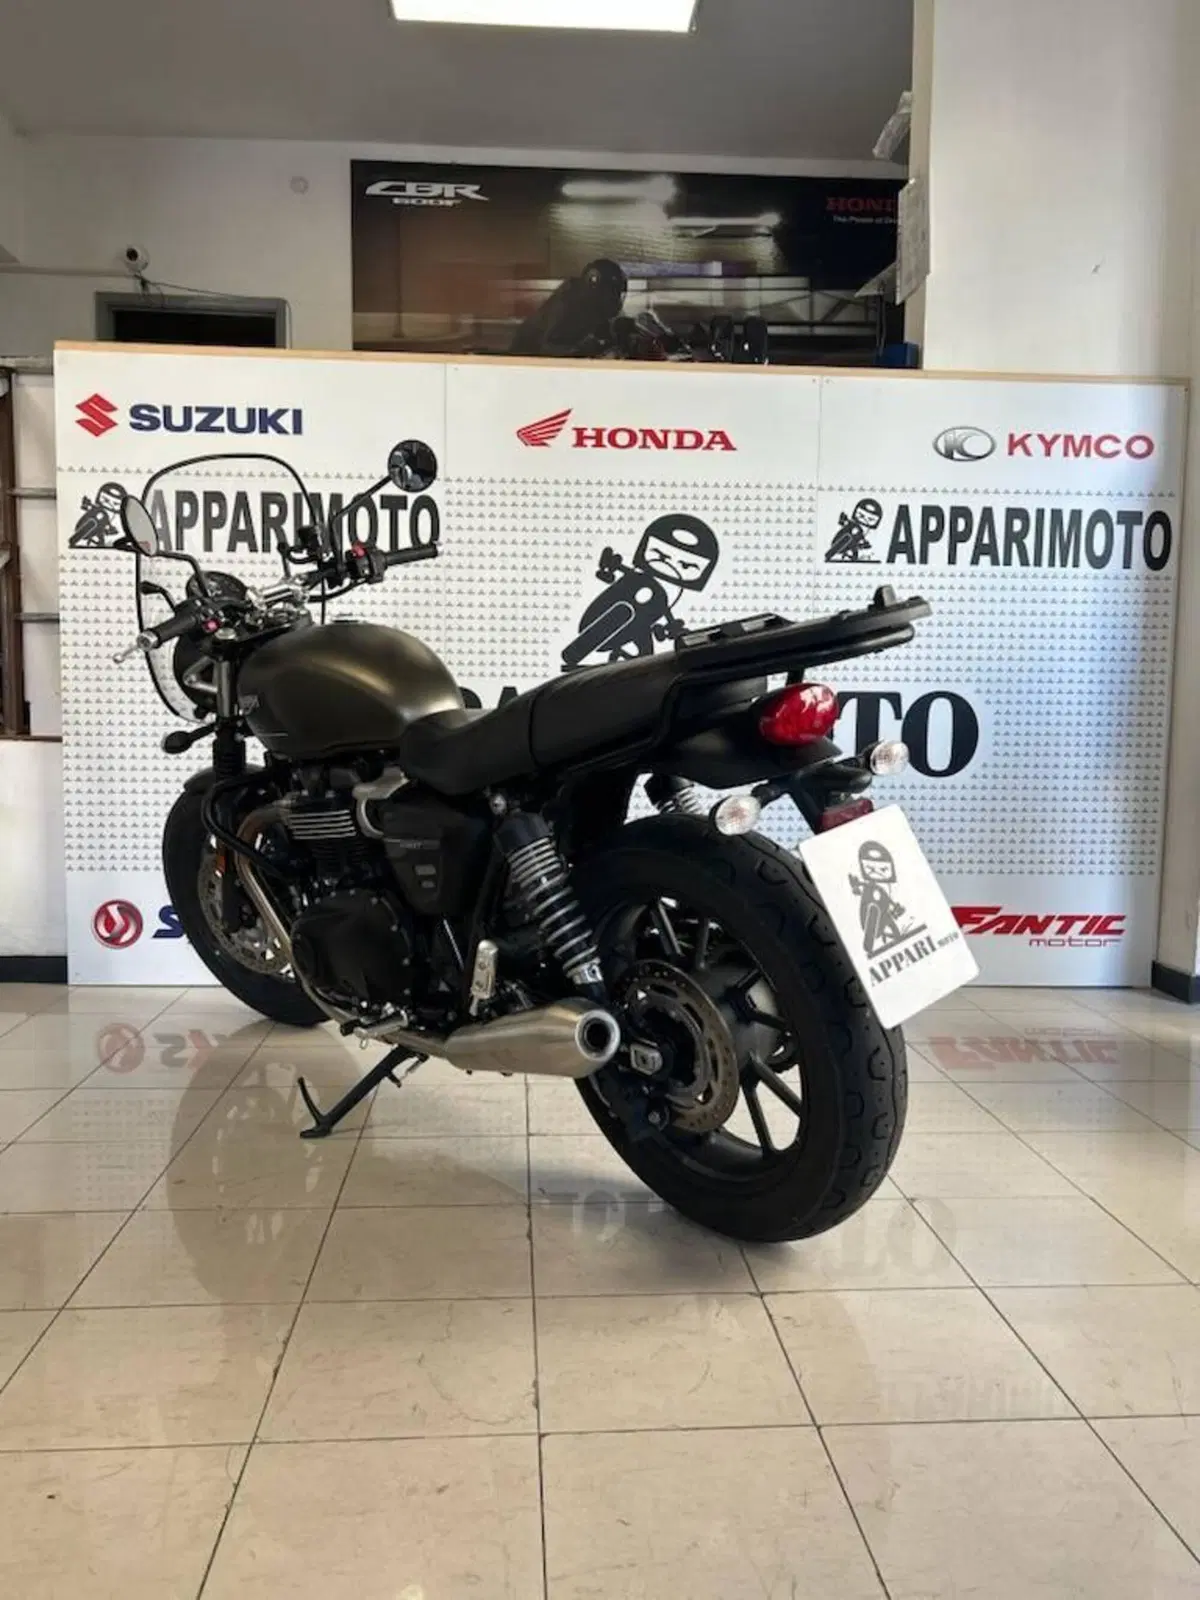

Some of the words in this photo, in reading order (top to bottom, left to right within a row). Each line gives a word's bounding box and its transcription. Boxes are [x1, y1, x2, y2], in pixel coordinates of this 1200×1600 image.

[365, 181, 489, 201] CBR
[129, 404, 303, 435] SUZUKI
[572, 427, 737, 451] HONDA
[1007, 433, 1155, 460] KYMCO
[887, 503, 1172, 571] APPARIMOTO
[950, 906, 1126, 936] FANTIC
[1028, 938, 1121, 948] motor
[869, 935, 937, 987] APPARI
